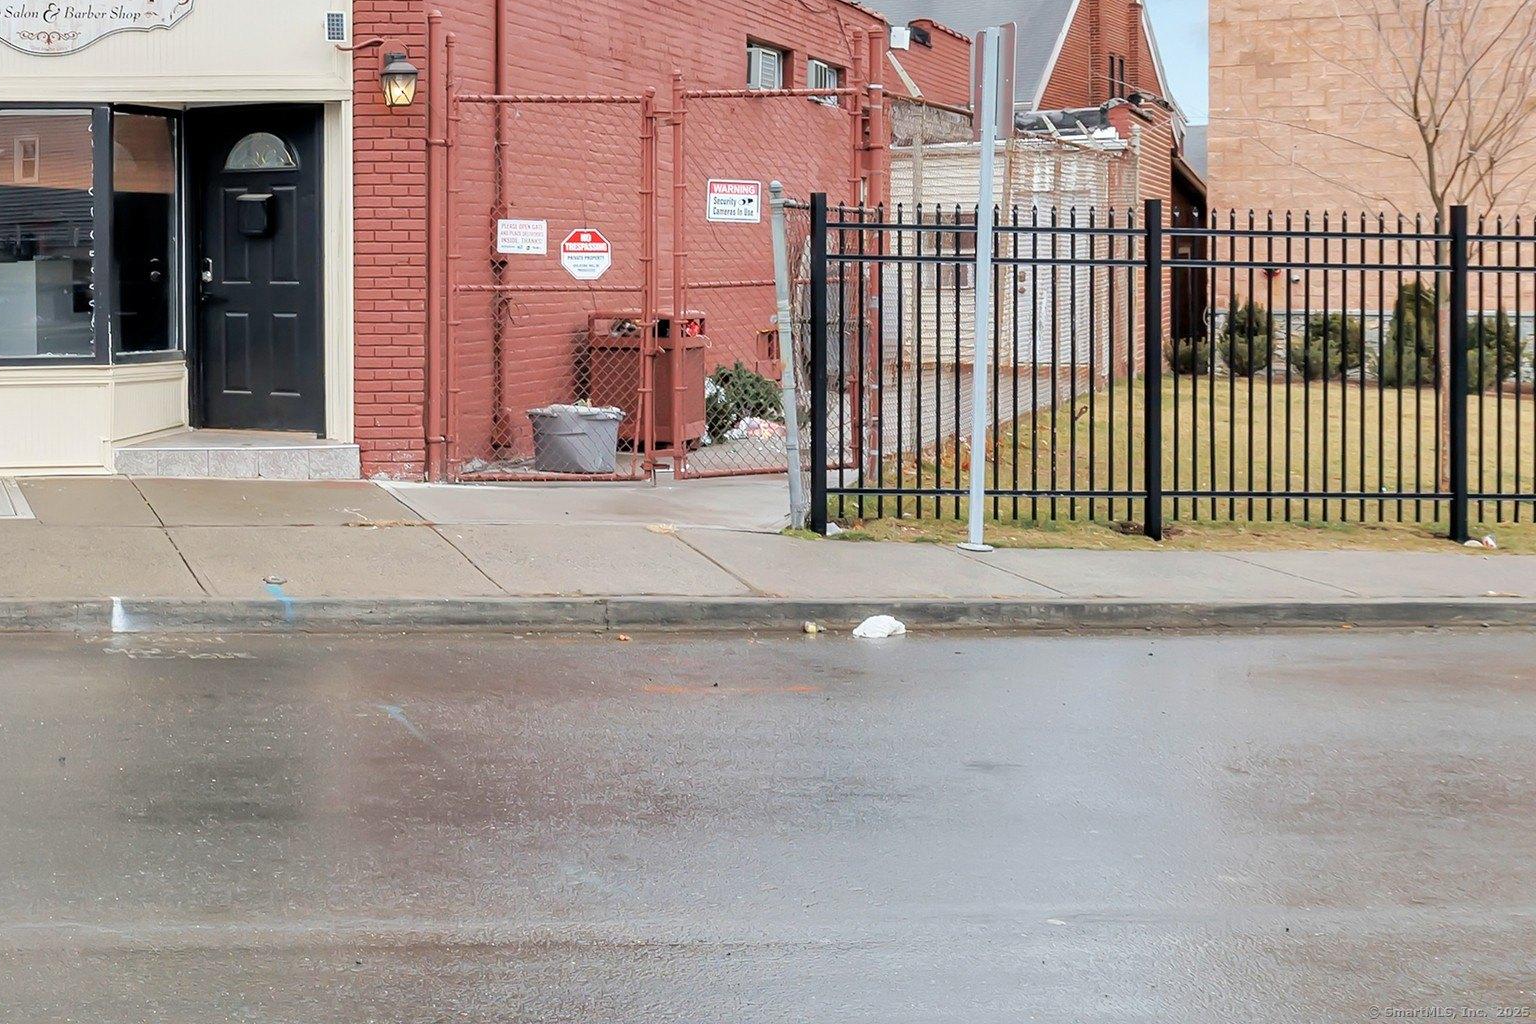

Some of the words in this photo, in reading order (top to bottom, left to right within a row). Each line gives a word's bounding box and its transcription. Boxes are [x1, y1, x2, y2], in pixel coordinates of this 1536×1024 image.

[4, 5, 40, 20] Salon
[42, 2, 61, 23] &
[64, 6, 107, 20] Barber
[110, 5, 142, 23] Shop
[713, 183, 756, 196] WARNING
[713, 196, 737, 208] Security
[713, 207, 736, 216] Cameras
[744, 208, 754, 217] Use
